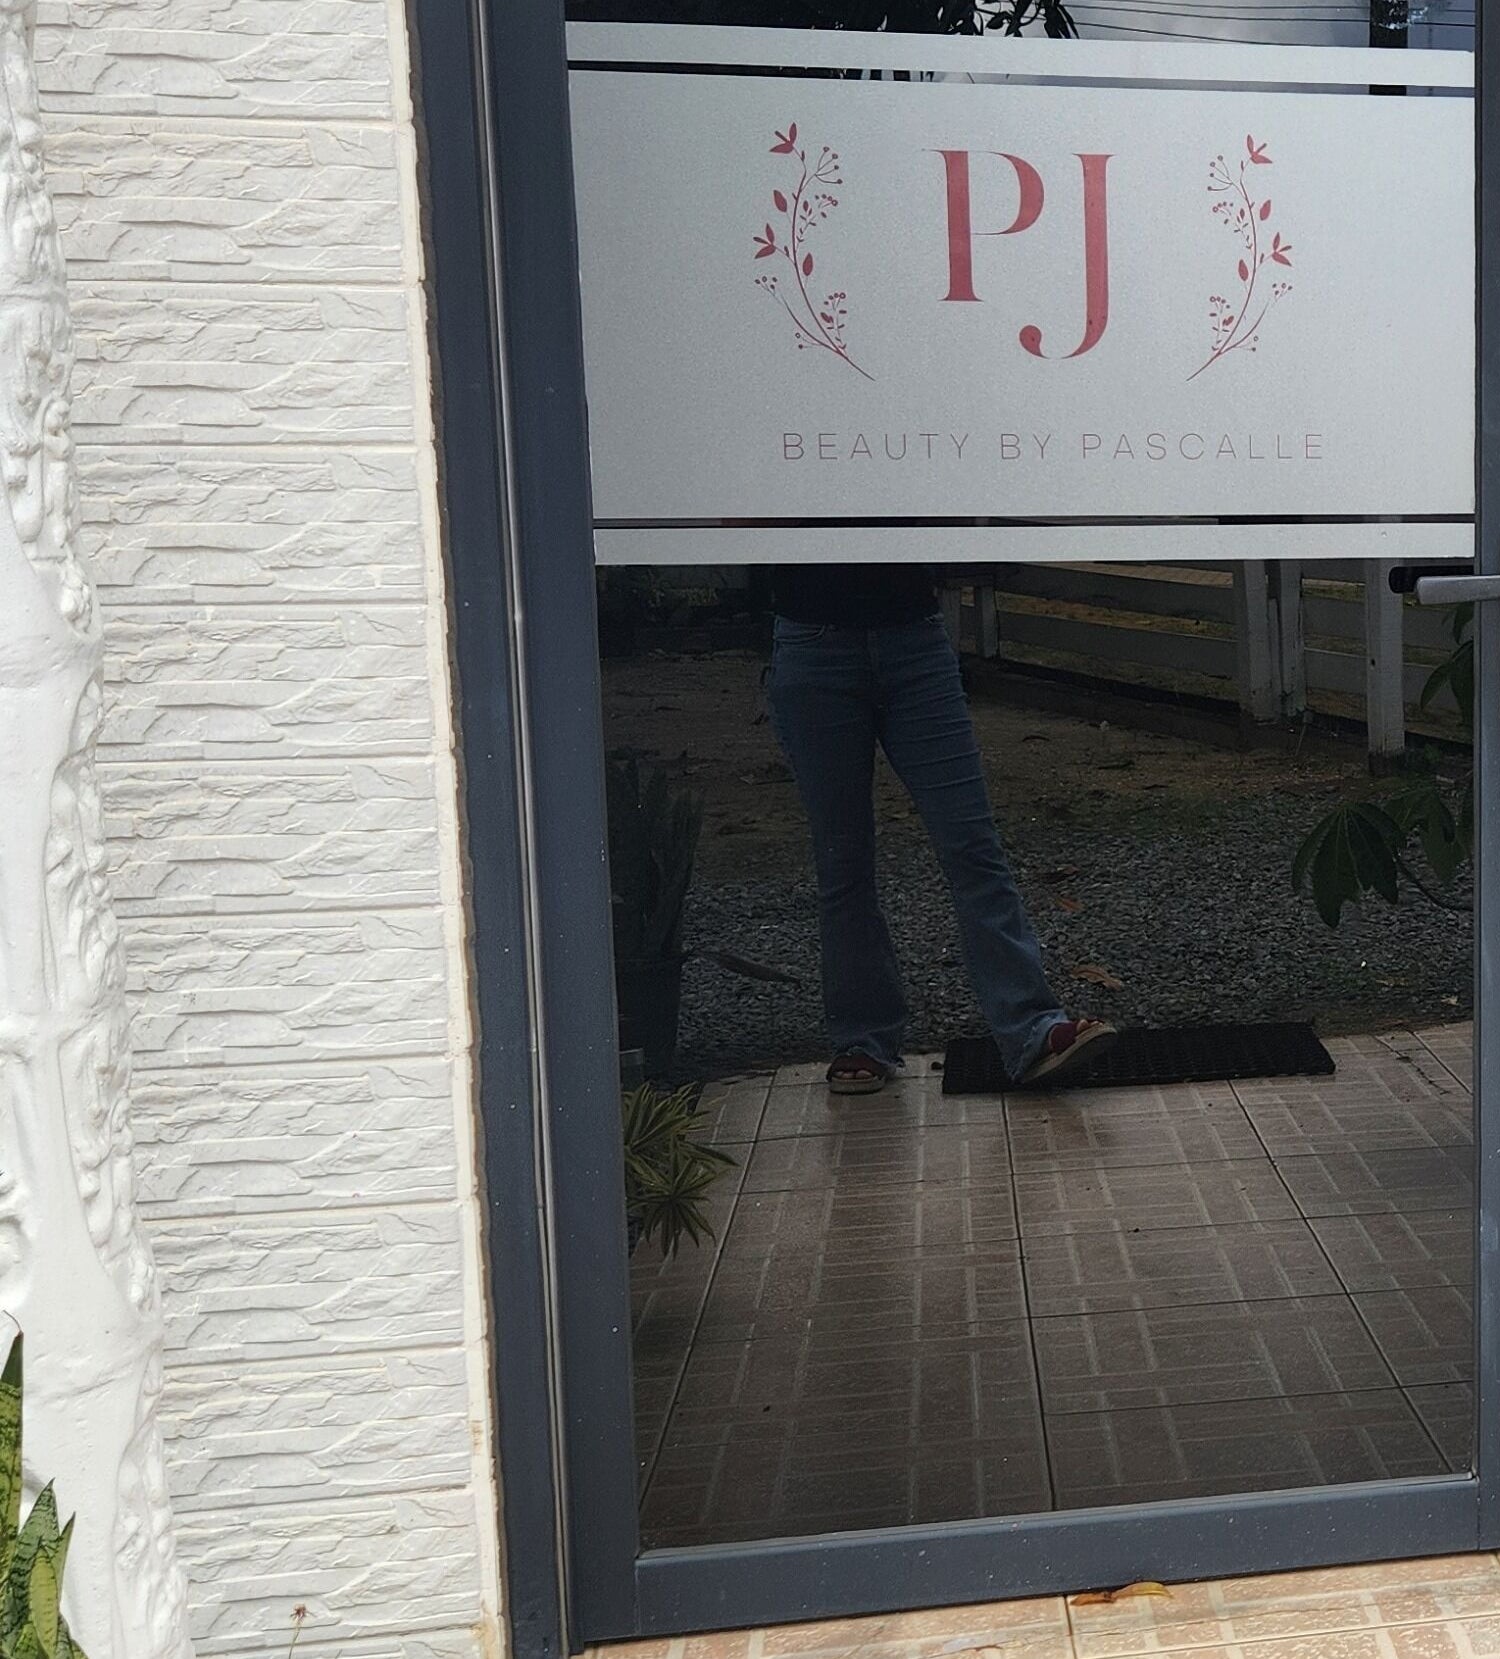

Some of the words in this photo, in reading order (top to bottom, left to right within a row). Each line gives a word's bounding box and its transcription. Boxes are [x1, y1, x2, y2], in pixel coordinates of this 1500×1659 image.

[924, 148, 1117, 360] PJ
[782, 432, 970, 461] BEAUTY
[999, 432, 1052, 461] BY
[1081, 432, 1324, 461] PASCALLE
